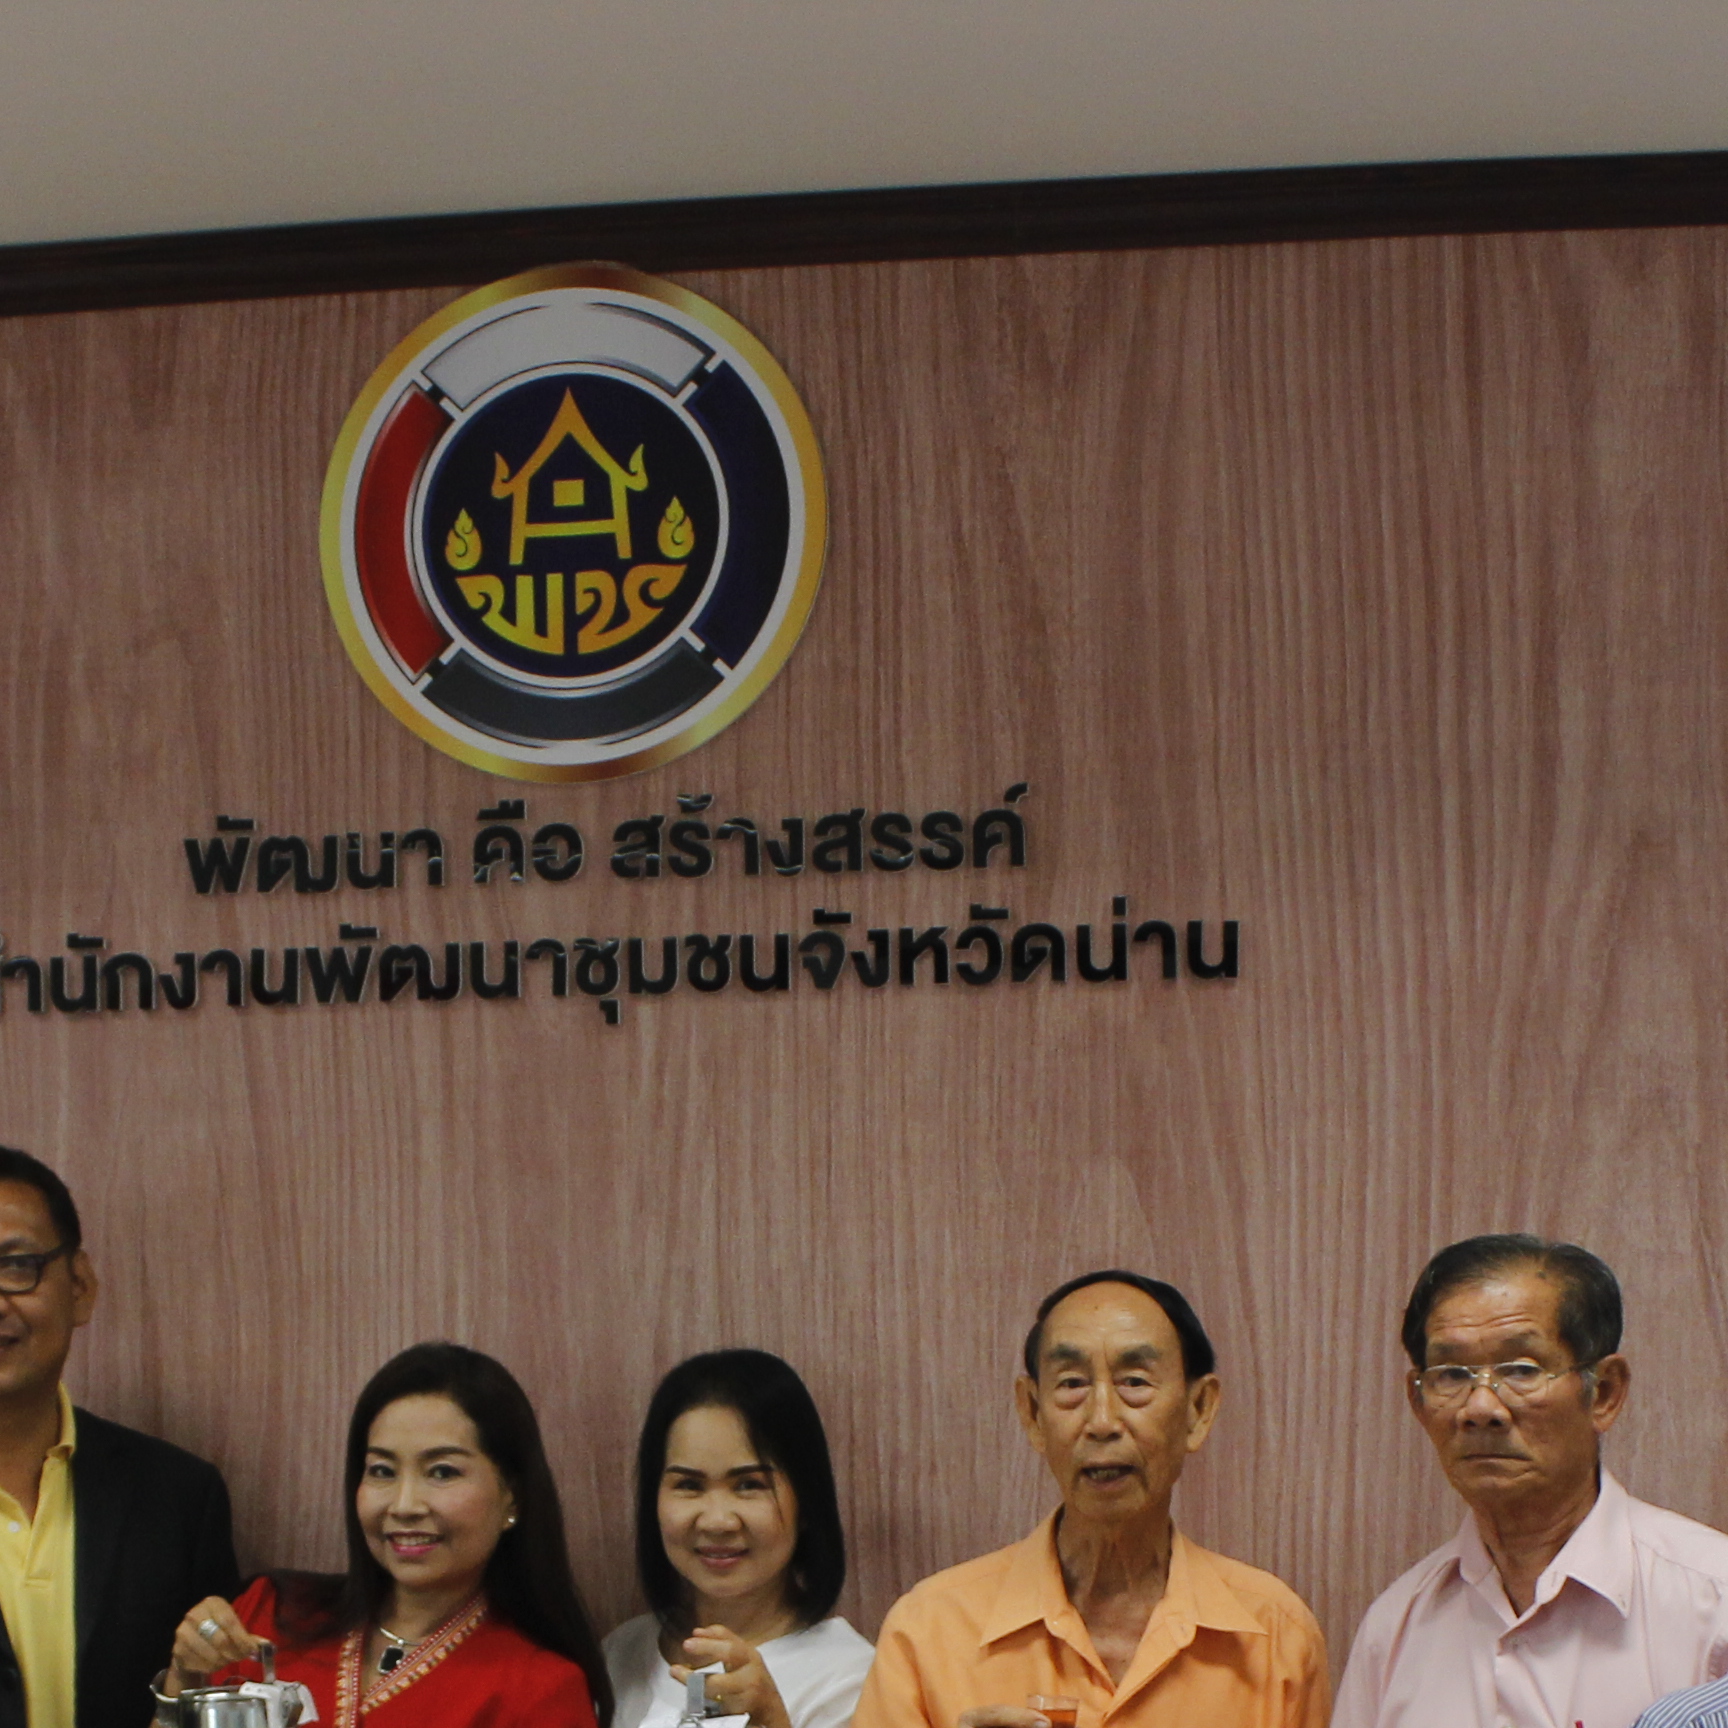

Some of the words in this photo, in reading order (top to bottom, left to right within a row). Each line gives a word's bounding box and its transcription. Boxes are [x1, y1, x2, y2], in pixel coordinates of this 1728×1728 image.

[183, 814, 446, 894] พัฒนา
[473, 799, 585, 884] คือ
[609, 783, 1029, 879] สร้างสรรค์
